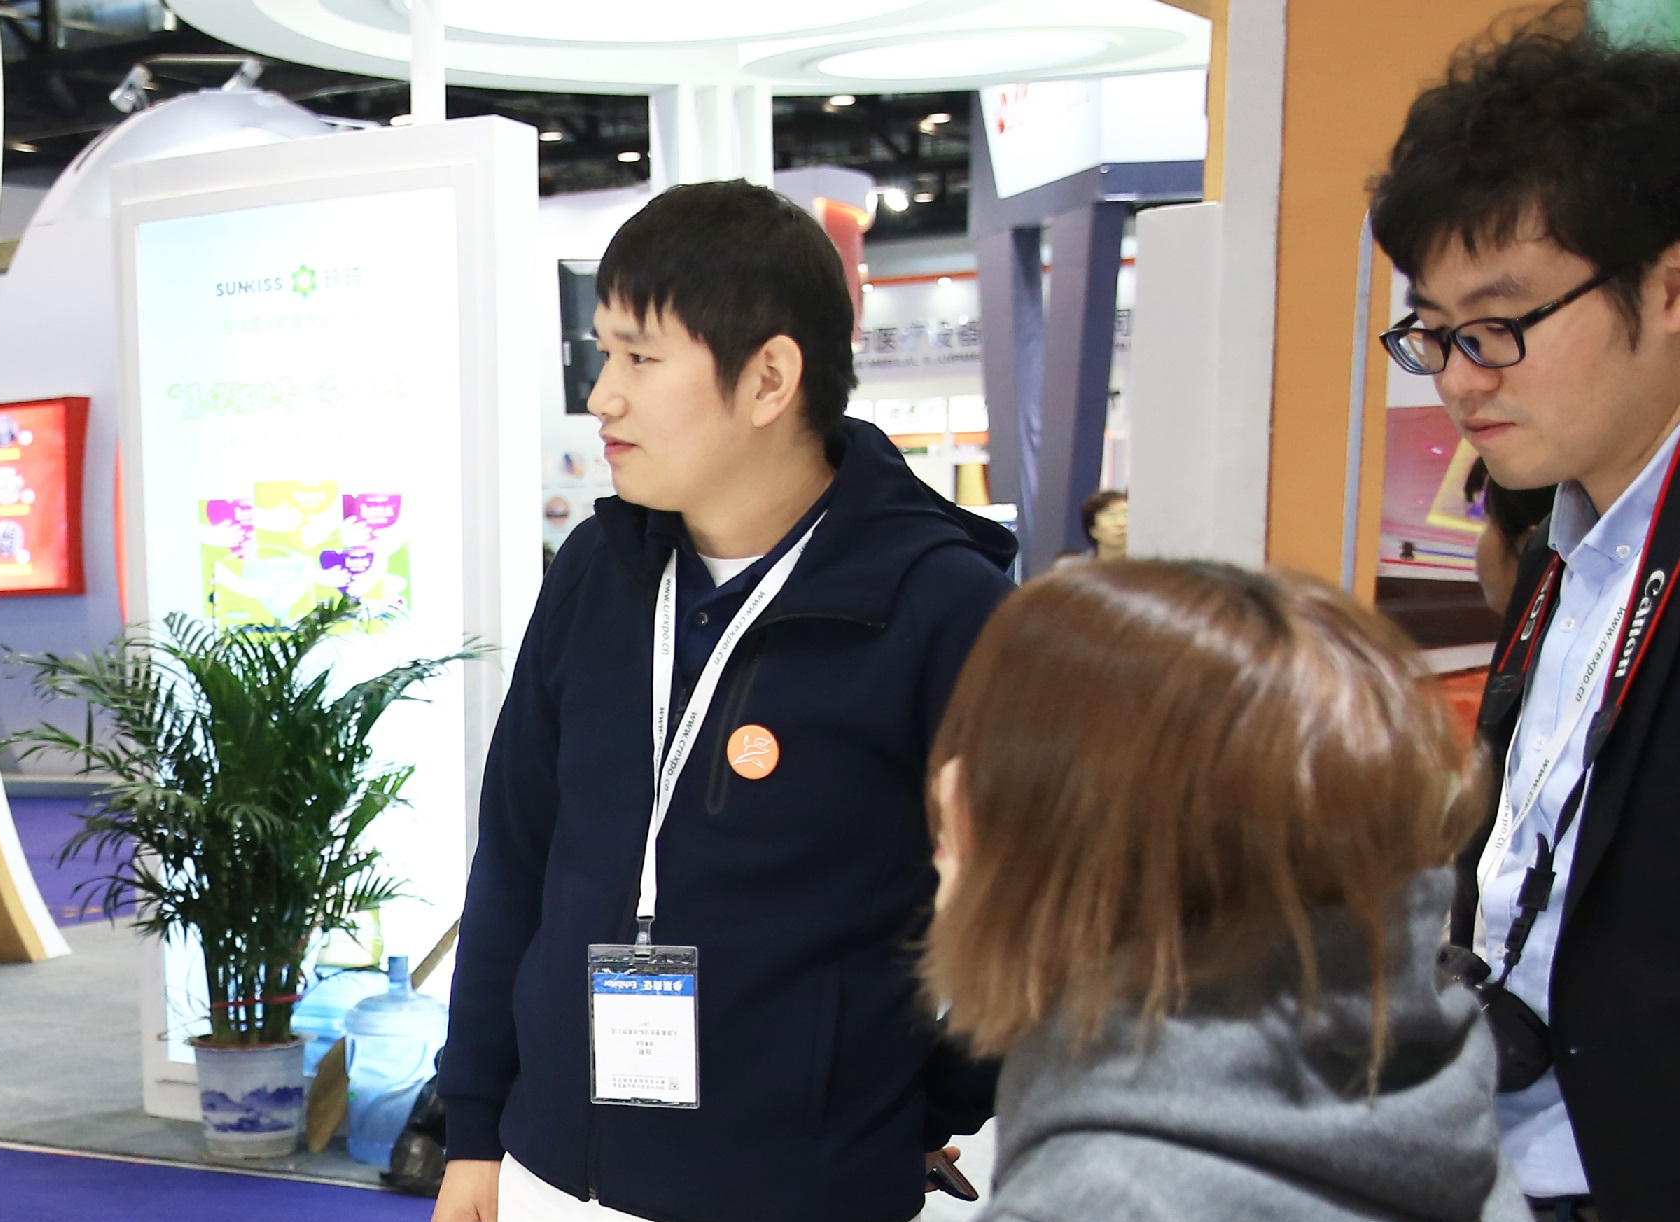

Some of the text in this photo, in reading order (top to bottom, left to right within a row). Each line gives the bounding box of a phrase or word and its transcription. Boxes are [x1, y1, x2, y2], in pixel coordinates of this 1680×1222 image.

[216, 277, 283, 297] SUNKISS
[661, 577, 672, 656] www.crexpo.cn
[714, 590, 766, 666] www.crexpo.cn
[1574, 606, 1626, 703] www.crexpo.cn
[1614, 569, 1666, 678] Canon
[664, 711, 698, 792] www.crexpo.cn
